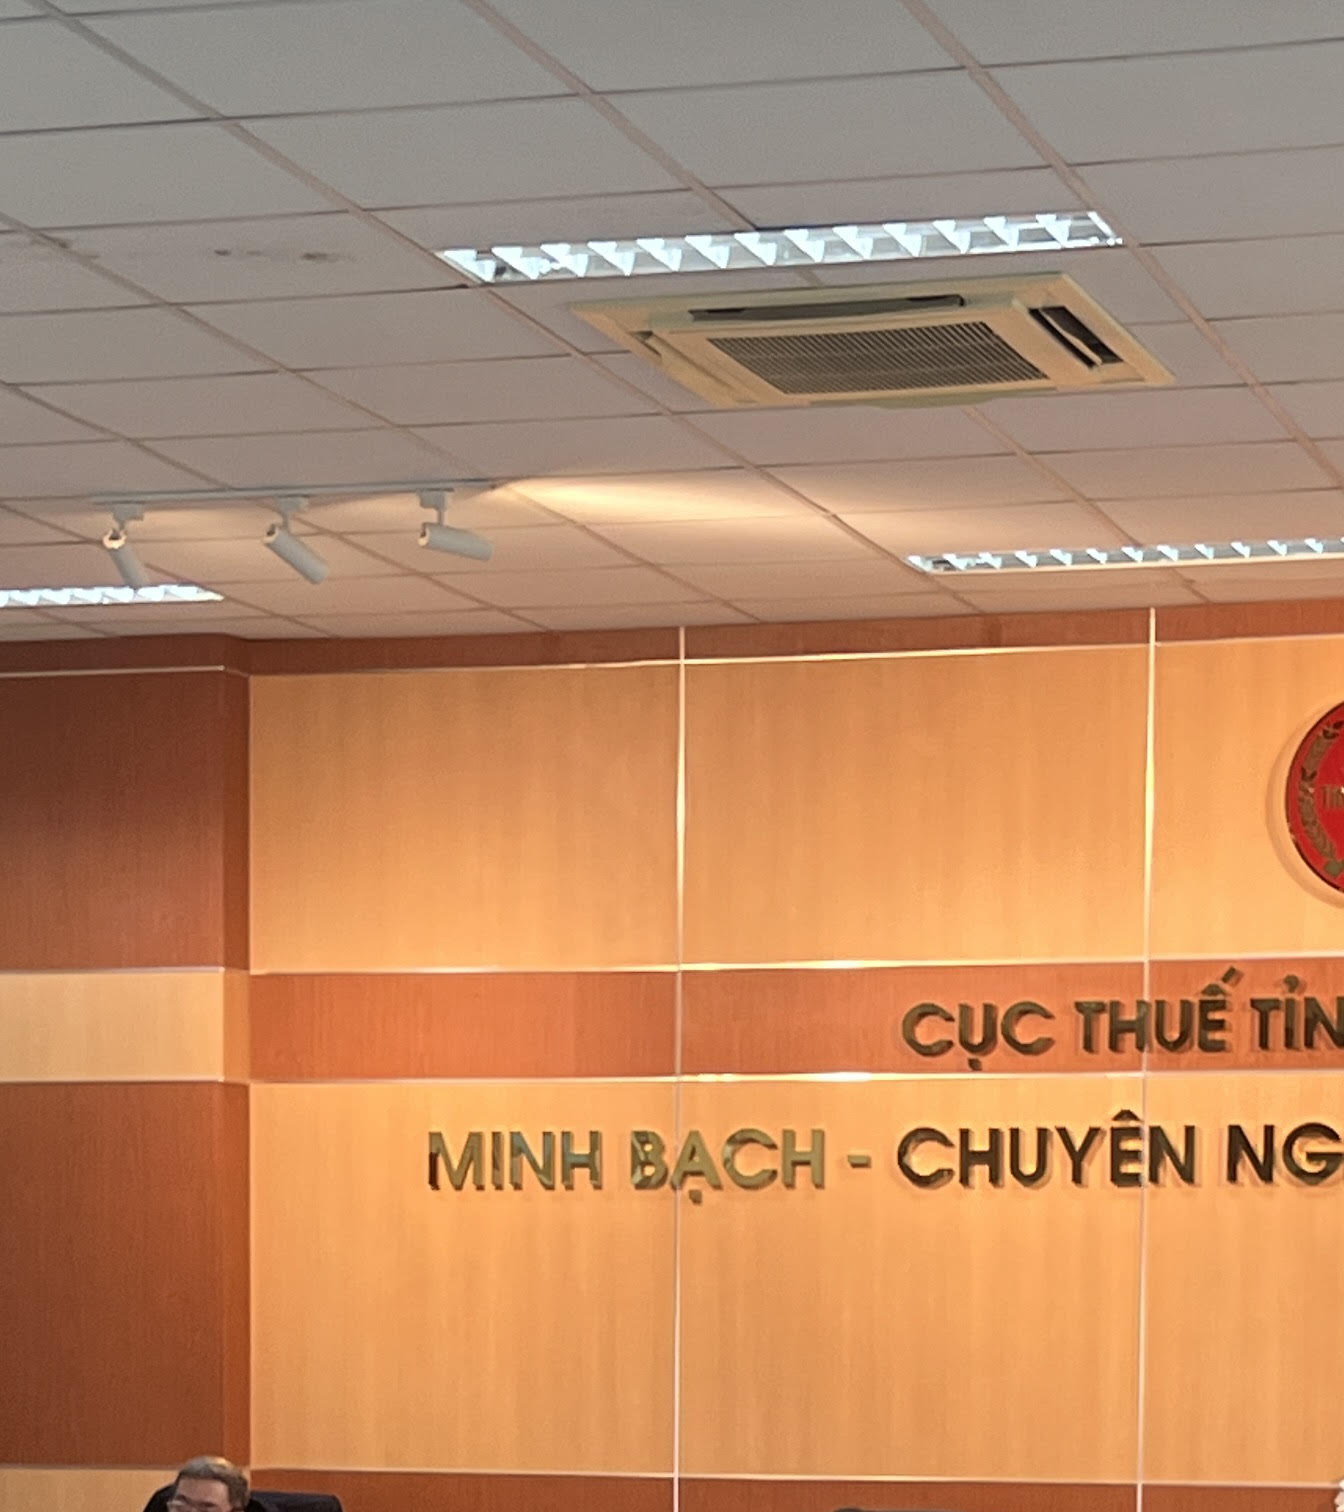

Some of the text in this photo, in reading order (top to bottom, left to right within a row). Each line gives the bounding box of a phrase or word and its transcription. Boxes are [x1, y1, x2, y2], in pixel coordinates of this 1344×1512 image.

[901, 1001, 1056, 1071] CỤC
[1074, 966, 1243, 1053] THUẾ
[428, 1130, 602, 1191] MINH
[630, 1127, 826, 1204] BẠCH
[897, 1109, 1195, 1188] CHUYÊN
